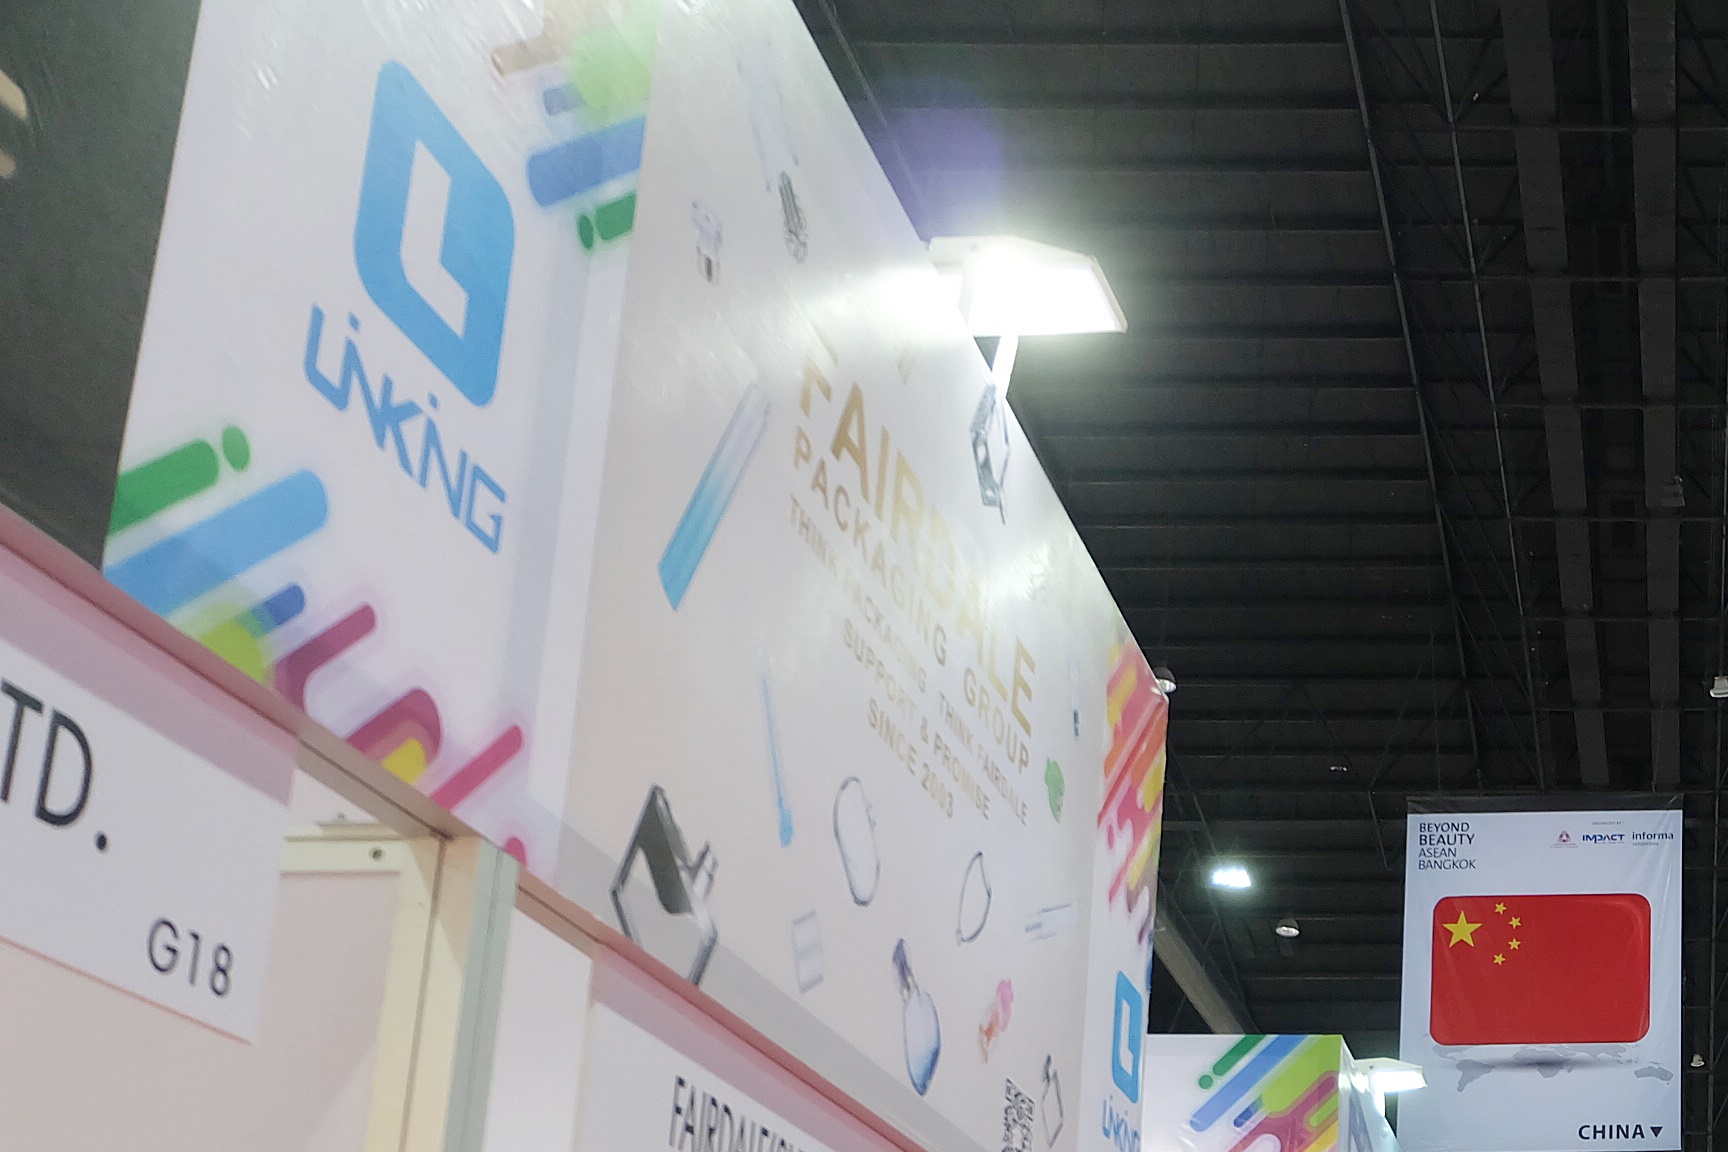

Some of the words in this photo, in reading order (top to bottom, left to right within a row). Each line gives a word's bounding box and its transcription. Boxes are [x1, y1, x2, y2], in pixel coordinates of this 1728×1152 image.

[962, 665, 1031, 776] GROUP
[867, 697, 918, 778] SINCE
[1419, 822, 1470, 833] BEYOND
[1419, 834, 1475, 846] BEAUTY
[1582, 833, 1625, 843] IMPACT
[1632, 831, 1675, 841] informa
[1418, 847, 1457, 858] ASEAN
[1418, 858, 1477, 871] BANGKOK
[146, 918, 234, 999] G18
[1578, 1123, 1646, 1140] CHINA
